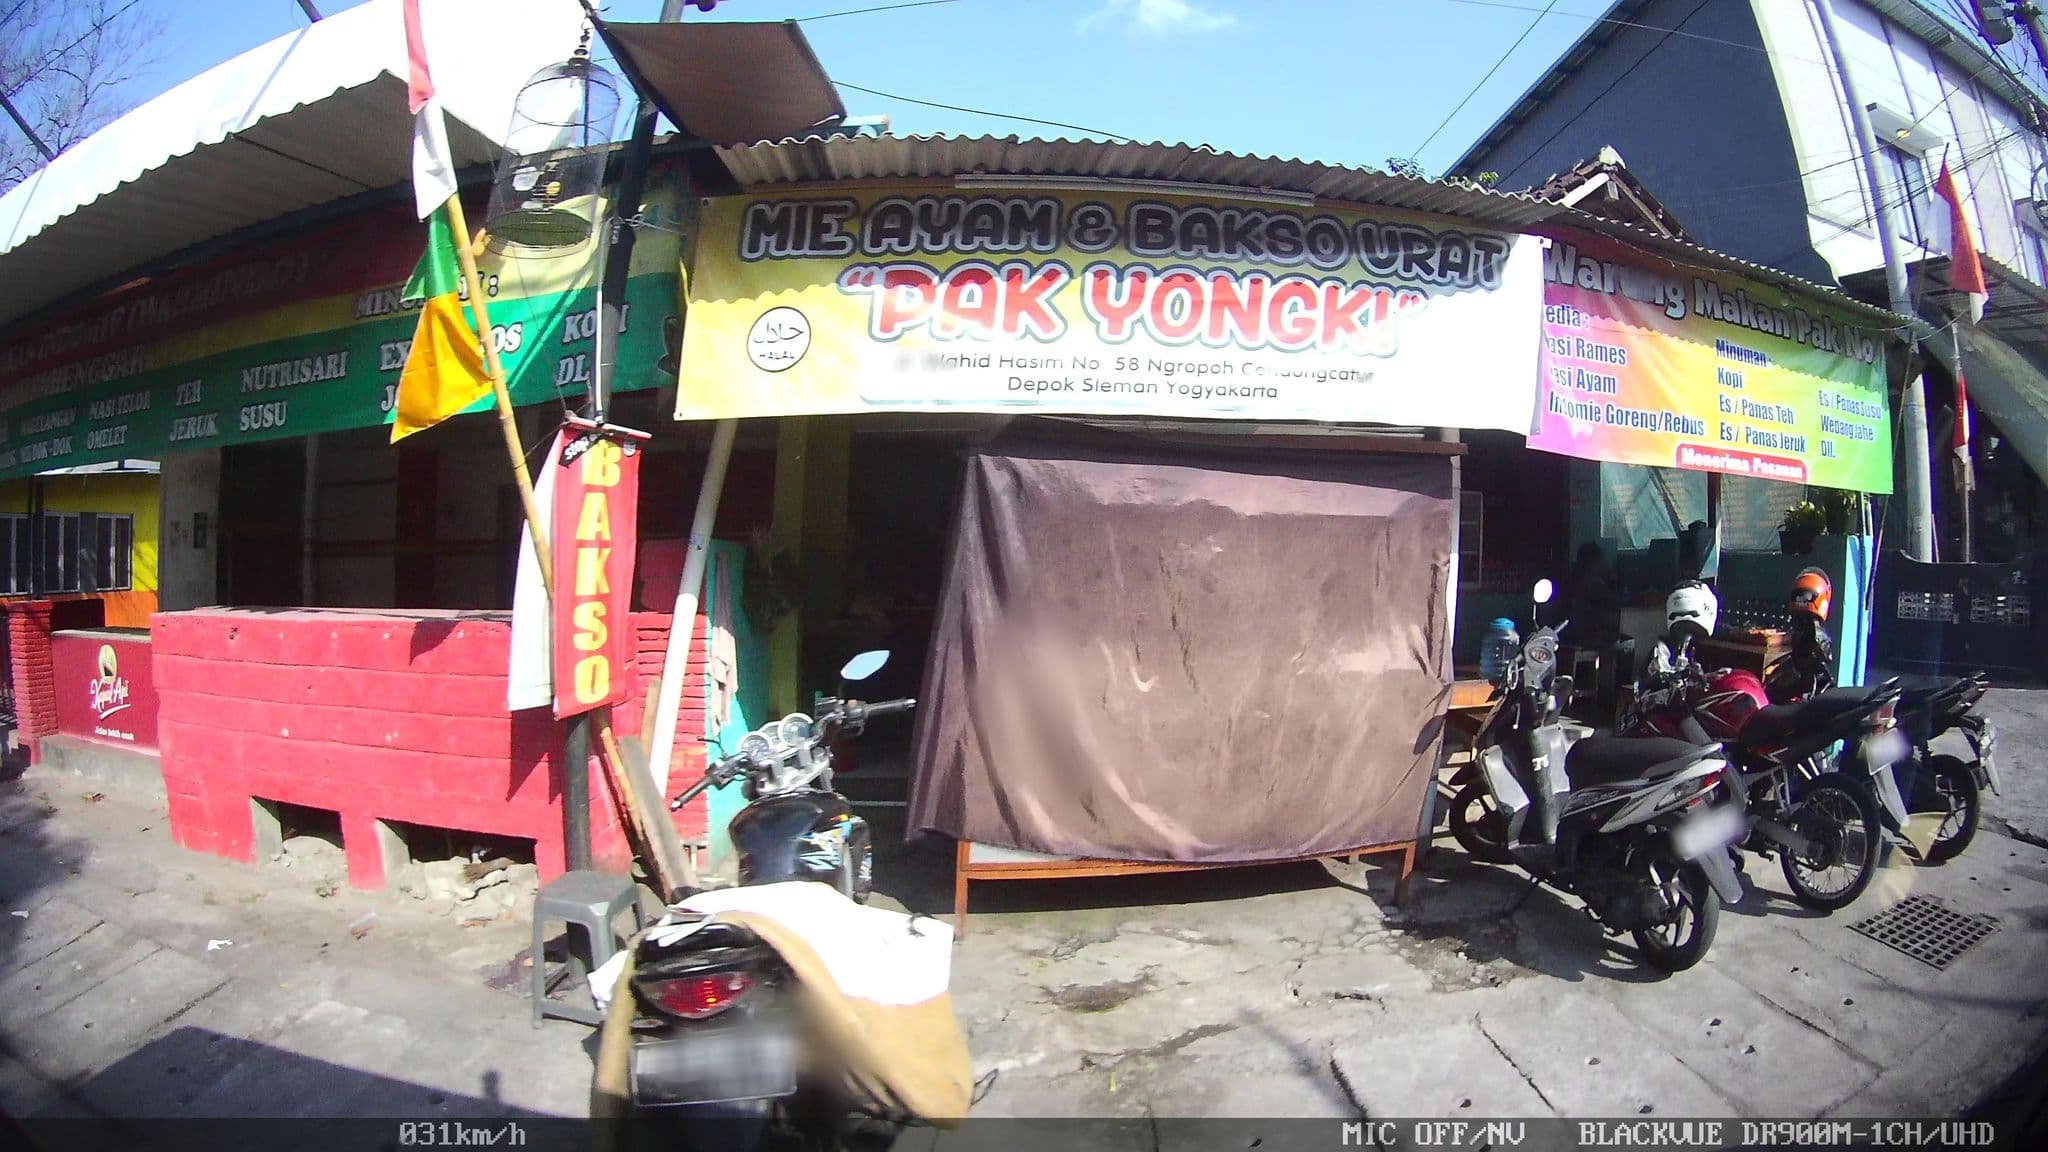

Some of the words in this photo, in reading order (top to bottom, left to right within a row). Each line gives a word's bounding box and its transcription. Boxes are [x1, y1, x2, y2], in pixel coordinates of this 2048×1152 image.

[741, 198, 857, 260] MIE
[862, 196, 1061, 255] AYAM
[1066, 201, 1118, 253] &
[1129, 200, 1351, 268] BAKSO
[1353, 215, 1511, 289] URAT
[562, 304, 629, 343] KOI
[1693, 277, 1793, 340] Makan
[1794, 308, 1842, 356] Pak
[921, 354, 991, 370] ahid
[999, 355, 1064, 370] Hasim
[1115, 357, 1139, 372] 58
[1148, 358, 1235, 377] Ngropoh
[1576, 338, 1627, 365] Rames
[241, 351, 348, 393] NUTRISARI
[1576, 368, 1617, 394] Ayam
[1717, 367, 1743, 389] Kopi
[176, 379, 202, 406] TEH
[1008, 376, 1075, 395] Depok
[1082, 377, 1158, 395] Sleman
[1167, 381, 1278, 400] Yogyakarta
[1819, 390, 1830, 408] Es
[1837, 394, 1861, 416] Panas
[240, 401, 289, 431] SUSU
[1606, 403, 1705, 436] Goreng/Rebus
[1719, 394, 1732, 413] Es
[1742, 400, 1775, 421] Panas
[1776, 405, 1794, 425] Teh
[169, 412, 219, 441] JERUK
[1720, 422, 1733, 442] Es
[1745, 427, 1778, 449] Panas
[1780, 430, 1806, 453] Jeruk
[573, 439, 621, 704] BAKSO
